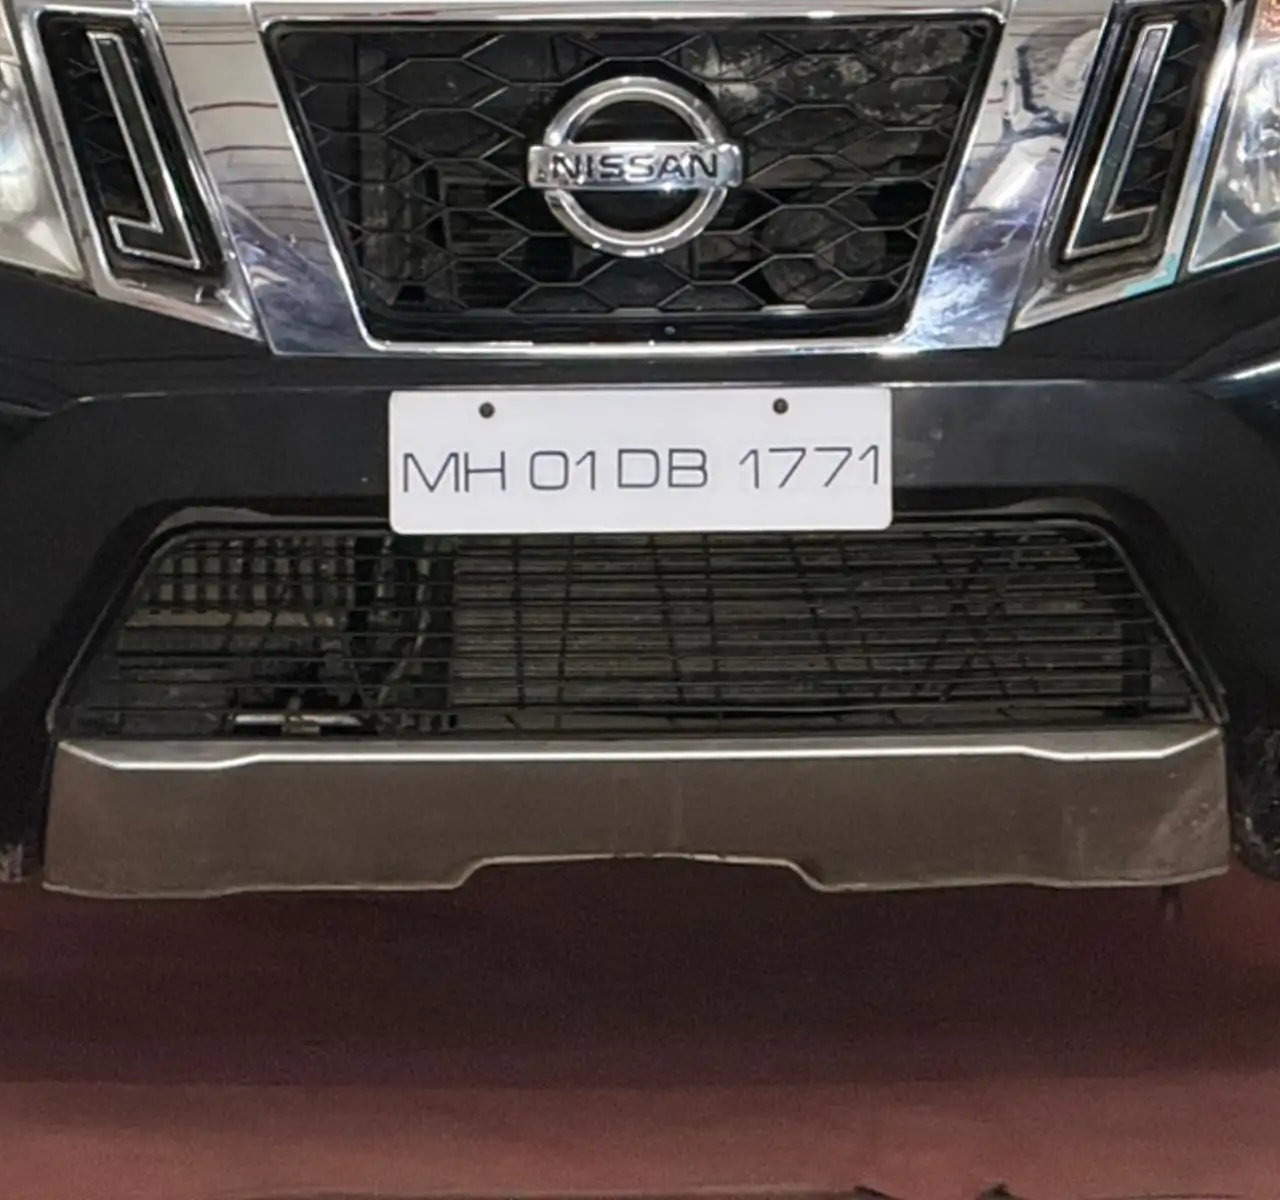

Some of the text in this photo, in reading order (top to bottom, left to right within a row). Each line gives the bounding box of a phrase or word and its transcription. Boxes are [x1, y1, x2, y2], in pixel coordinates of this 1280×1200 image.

[551, 153, 718, 180] NISSAN
[402, 450, 506, 493] MH
[739, 444, 880, 490] 1771
